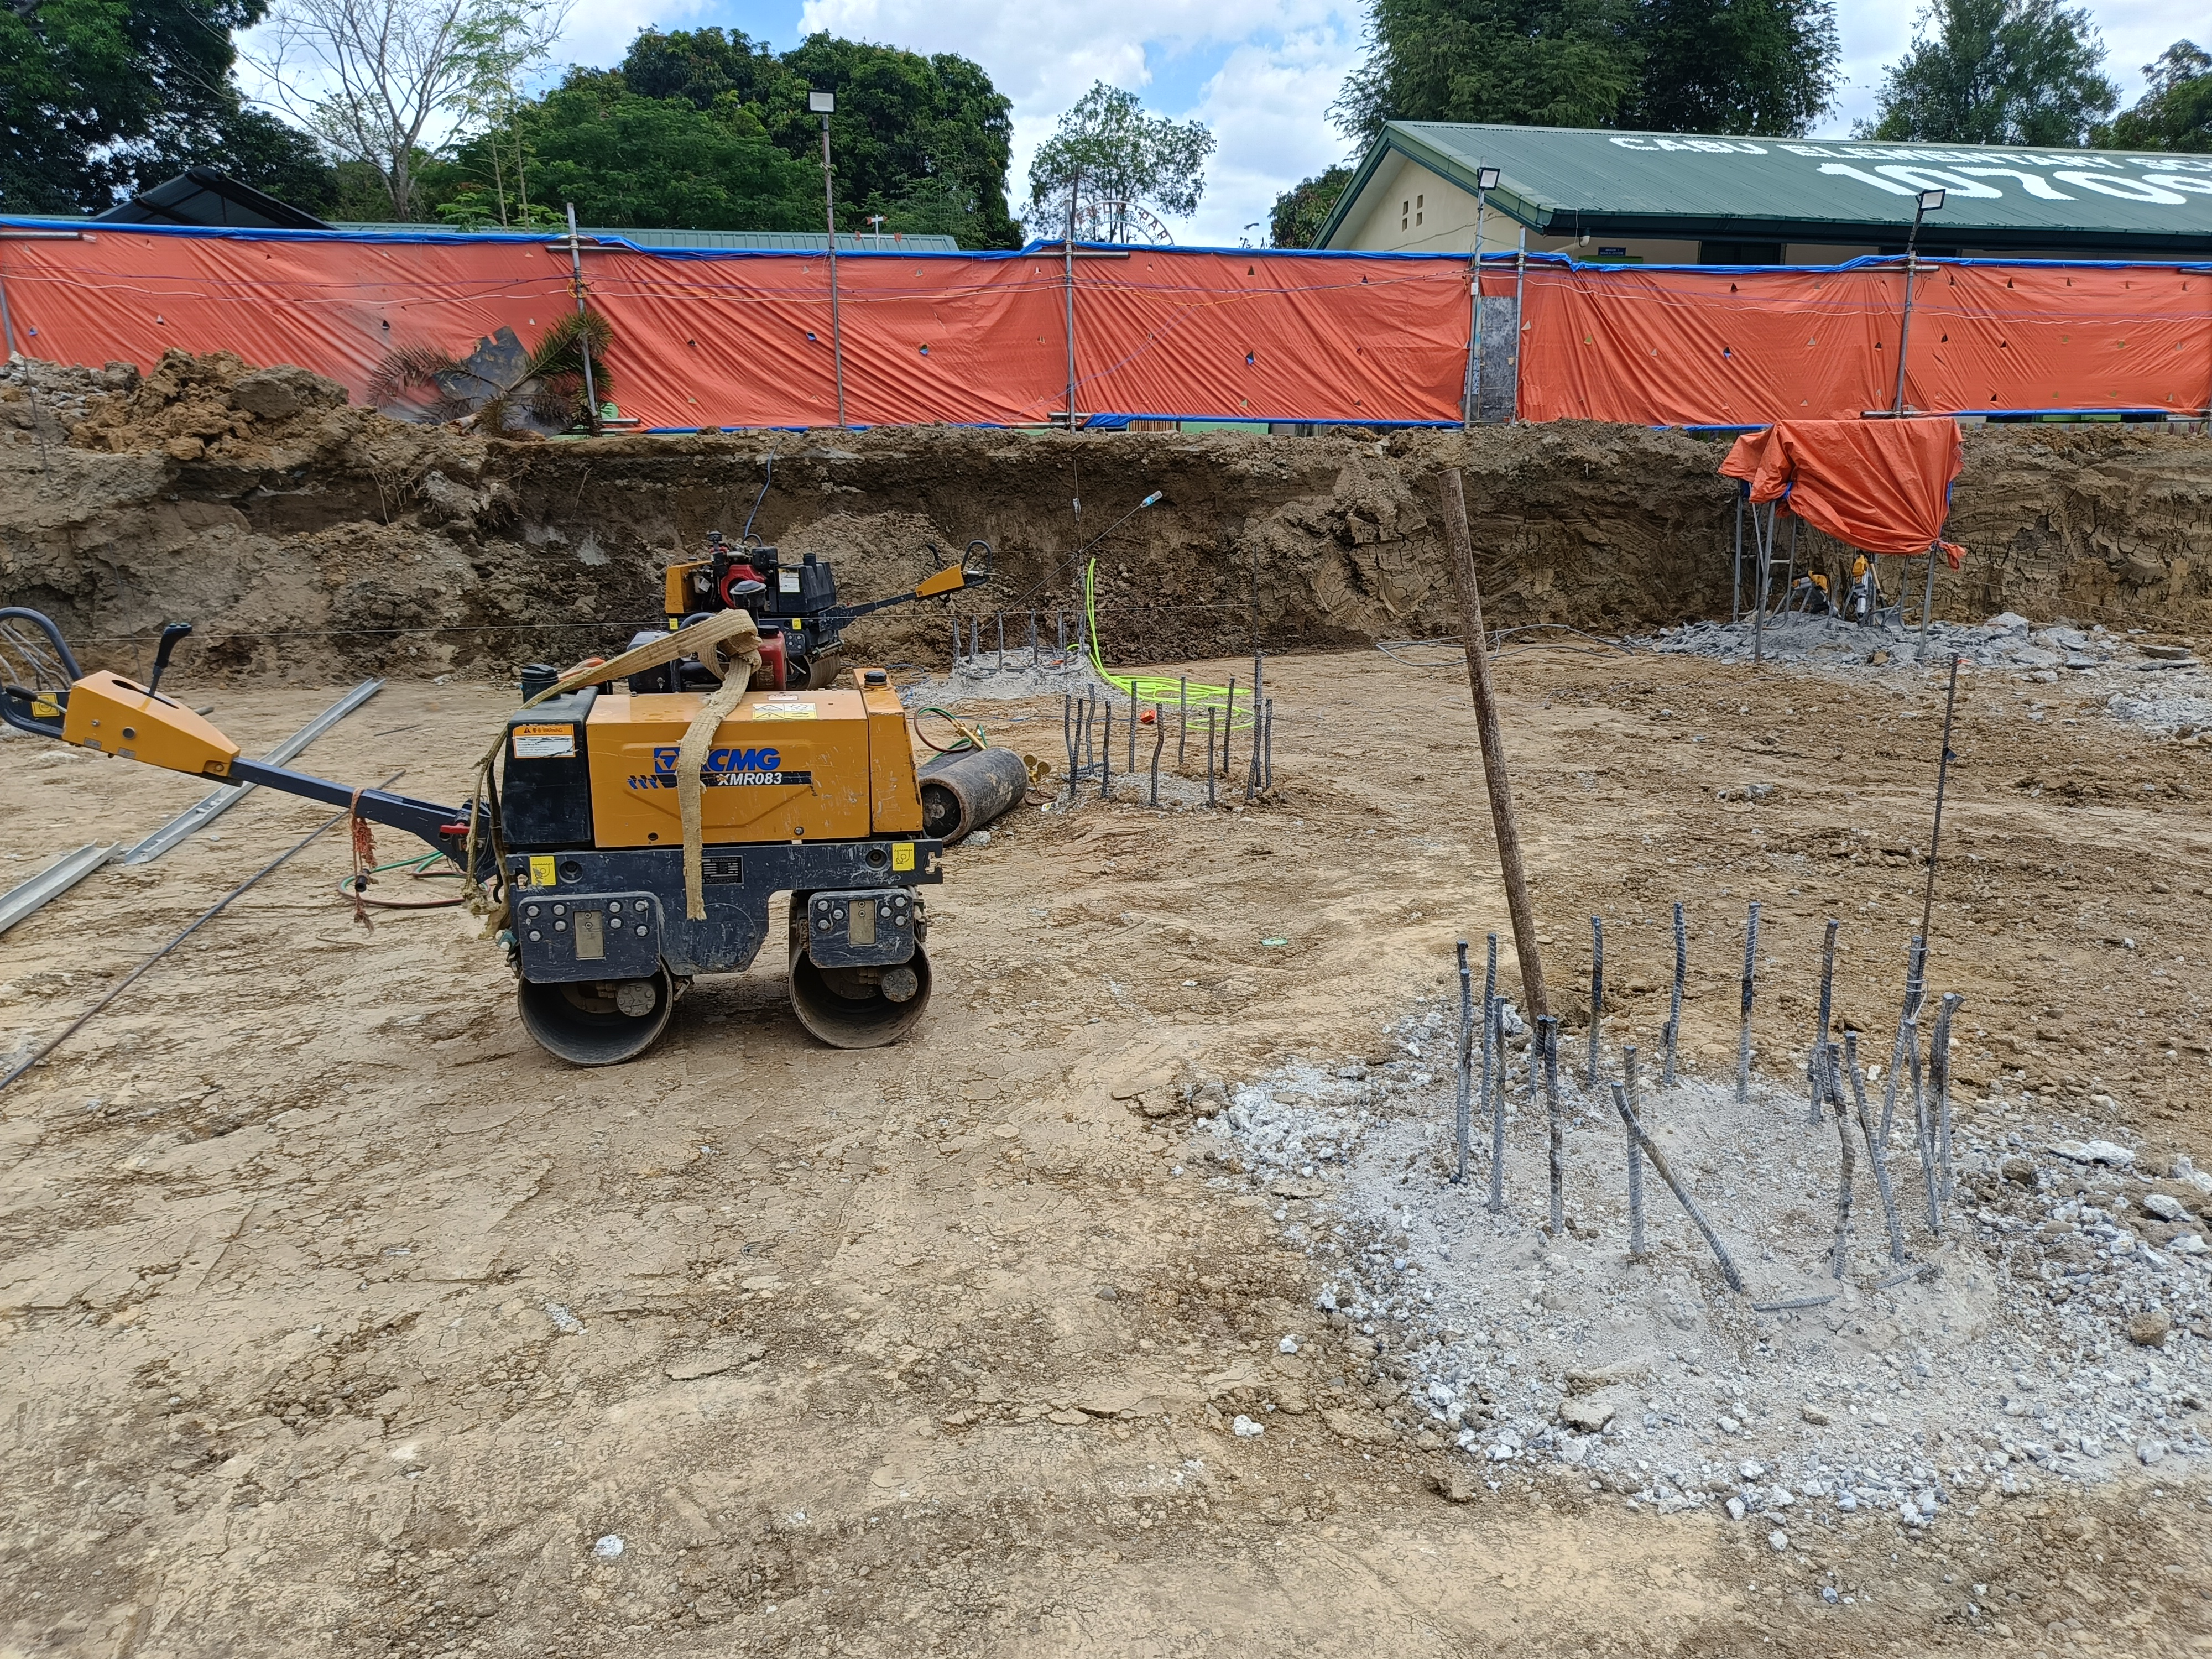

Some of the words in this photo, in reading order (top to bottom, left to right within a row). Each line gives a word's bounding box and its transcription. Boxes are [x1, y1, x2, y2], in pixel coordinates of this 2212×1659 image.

[1609, 137, 1768, 155] CABU
[1776, 144, 2125, 168] ELEMENTARY
[1140, 210, 1174, 246] PAR
[718, 773, 782, 786] XMR083
